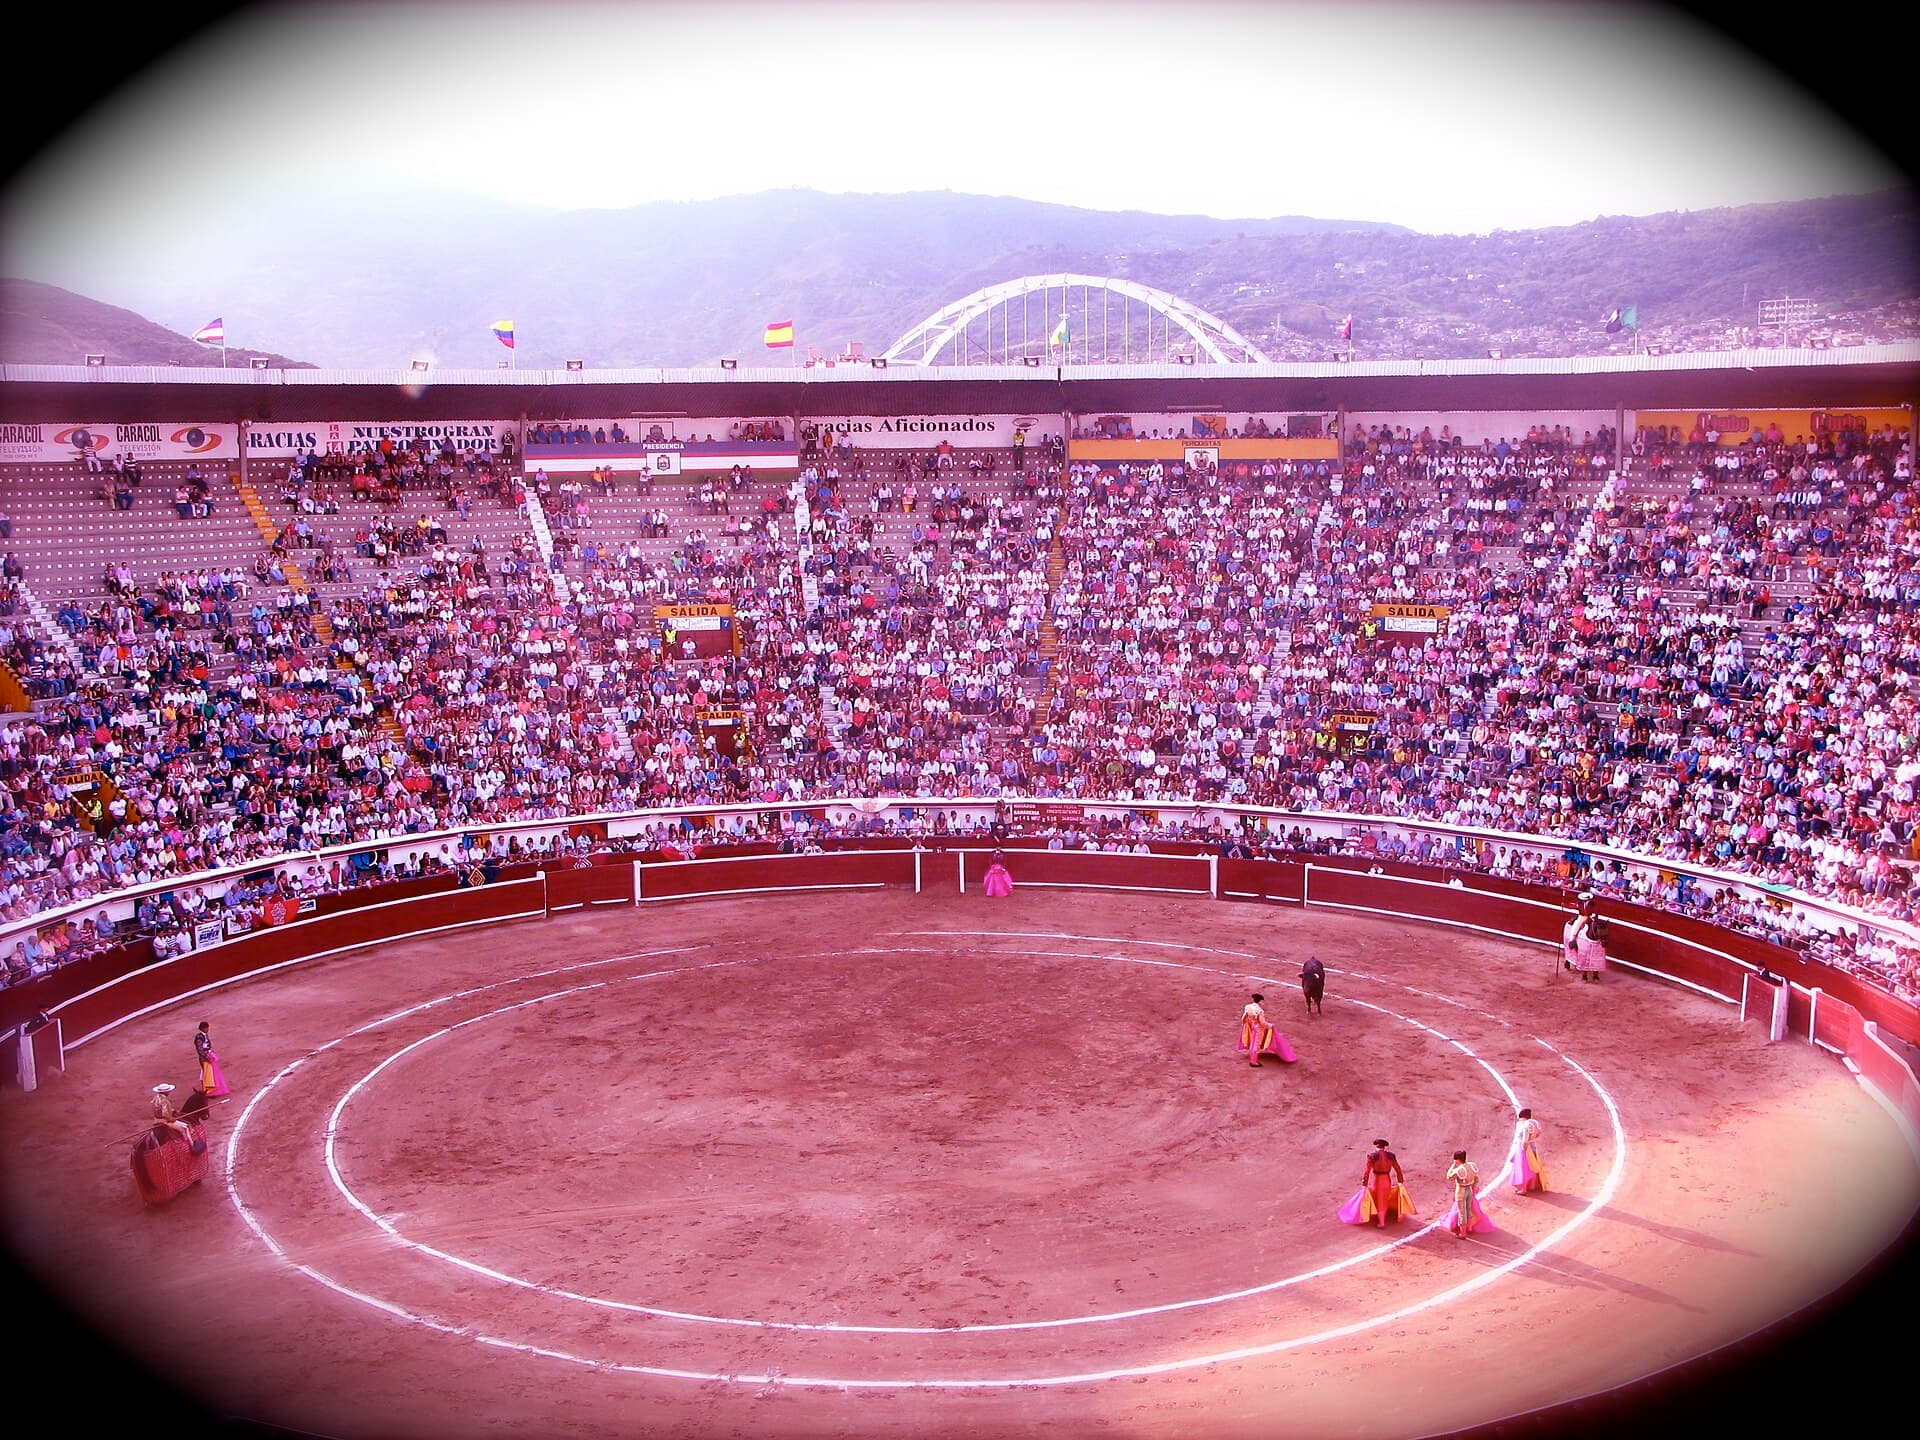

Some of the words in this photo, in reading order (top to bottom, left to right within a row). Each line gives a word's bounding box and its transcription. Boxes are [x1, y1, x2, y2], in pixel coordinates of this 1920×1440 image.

[353, 426, 441, 438] NUESTRO
[443, 425, 495, 437] GRAN
[878, 418, 995, 433] Aficionados
[0, 426, 44, 443] ARACOL
[116, 425, 162, 442] CARACOL
[246, 432, 317, 448] RACIAS
[327, 442, 343, 455] 14
[348, 439, 498, 450] PATOINDOR
[670, 607, 718, 617] SALIDA
[1388, 607, 1436, 617] SALIDA
[702, 711, 738, 719] SALIDA
[1340, 716, 1375, 724] SALIDA
